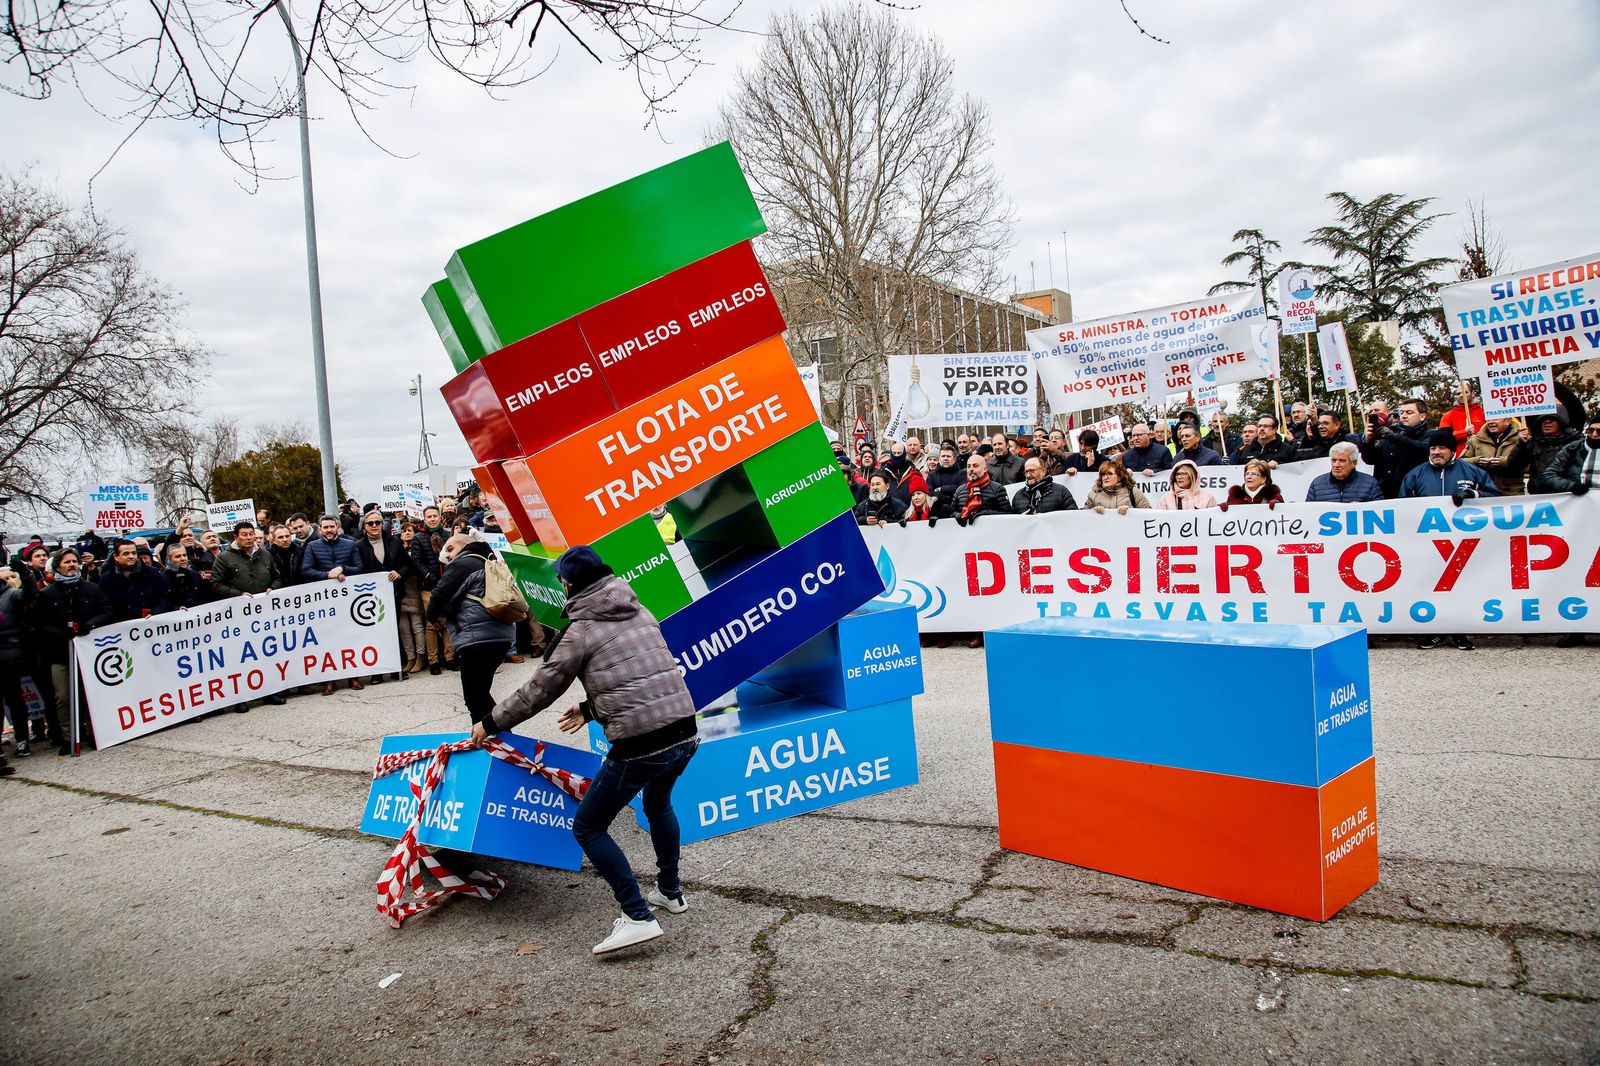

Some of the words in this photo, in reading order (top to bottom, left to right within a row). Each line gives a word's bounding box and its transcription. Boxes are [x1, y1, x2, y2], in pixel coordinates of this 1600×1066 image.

[1491, 281, 1513, 300] SI
[1519, 261, 1600, 295] RECOR
[1286, 307, 1316, 318] RECOR
[1292, 301, 1306, 310] NO
[1457, 287, 1595, 329] TRASVASE,
[1051, 346, 1061, 357] el
[1063, 341, 1090, 355] 50%
[1092, 336, 1133, 350] menos
[1135, 331, 1150, 342] de
[1152, 326, 1185, 340] agua
[1188, 320, 1207, 333] del
[1210, 306, 1266, 327] Trasvase
[1059, 331, 1078, 343] SR.
[1081, 318, 1149, 340] MINISTRA,
[1151, 316, 1168, 326] en
[1290, 320, 1314, 328] TRASVA
[1451, 334, 1476, 351] EL
[1478, 313, 1576, 347] FUTURO
[1580, 307, 1600, 328] D
[505, 362, 594, 412] EMPLEOS
[598, 320, 682, 368] EMPLEOS
[688, 282, 767, 328] EMPLEOS
[943, 357, 964, 366] SIN
[966, 354, 1028, 364] TRASVASE
[1078, 352, 1106, 364] 50%
[1108, 346, 1148, 360] menos
[1150, 341, 1166, 354] de
[1168, 332, 1219, 349] empleo,
[1485, 335, 1580, 366] MURCIA
[1584, 331, 1600, 349] Y
[943, 365, 1028, 379] DESIERTO
[1074, 369, 1081, 380] y
[1084, 365, 1098, 376] de
[1100, 358, 1146, 374] activida
[1164, 342, 1229, 362] conómica,
[1487, 368, 1500, 378] En
[1502, 367, 1510, 376] el
[1511, 364, 1547, 376] Levante
[943, 382, 958, 396] Y
[965, 380, 1028, 396] PARO
[1063, 380, 1093, 394] NOS
[1095, 371, 1146, 389] QUITAN
[1108, 388, 1117, 398] Y
[1122, 385, 1138, 396] EL
[1490, 383, 1548, 400] DESIERTO
[1493, 376, 1513, 388] SIN
[1514, 373, 1544, 386] AGUA
[945, 398, 984, 408] PARA
[988, 397, 1029, 408] MILES
[1500, 398, 1510, 408] Y
[1511, 393, 1545, 406] PARO
[597, 398, 701, 465] FLOTA
[698, 372, 745, 412] DE
[945, 412, 962, 422] DE
[966, 410, 1029, 420] FAMILIAS
[1100, 420, 1112, 428] AL
[584, 394, 788, 517] TRANSPORTE
[90, 492, 149, 502] TRASVASE
[98, 485, 140, 494] MENOS
[764, 464, 836, 509] AGRICULTURA
[1136, 483, 1150, 494] IN
[96, 518, 145, 528] FUTURO
[98, 510, 142, 520] MENOS
[1144, 519, 1171, 538] En
[1178, 517, 1199, 538] el
[1208, 514, 1310, 540] Levante,
[1318, 508, 1396, 537] SIN
[1416, 502, 1564, 534] AGUA
[616, 552, 669, 584] ULTURA
[964, 542, 1402, 596] DESIERTO
[1432, 538, 1481, 592] Y
[1510, 534, 1600, 590] P
[520, 579, 568, 608] AGRICULTUR
[129, 606, 233, 642] Comunidad
[243, 603, 263, 616] de
[271, 585, 350, 611] Regantes
[673, 588, 798, 679] SUMIDERO
[800, 562, 846, 596] CO2
[1036, 600, 1268, 622] TRASVASE
[1308, 600, 1436, 623] TAJO
[1482, 596, 1588, 622] SEG
[152, 631, 212, 657] Campo
[220, 625, 241, 640] de
[250, 606, 338, 633] Cartagena
[177, 646, 224, 678] SIN
[240, 626, 319, 664] AGUA
[862, 643, 901, 662] AGUA
[846, 666, 862, 680] DE
[864, 655, 918, 676] TRASVASE
[118, 668, 264, 730] DESIERTO
[276, 660, 290, 682] Y
[304, 646, 379, 676] PARO
[1330, 682, 1357, 710] AGUA
[1318, 718, 1330, 736] DE
[1330, 700, 1368, 730] TRASVASE
[744, 728, 847, 778] AGUA
[514, 786, 566, 810] AGUA
[698, 794, 739, 828] DE
[744, 756, 892, 811] TRASVASE
[373, 794, 390, 820] DE
[486, 802, 508, 818] DE
[511, 807, 574, 830] TRASVAS
[1332, 814, 1356, 844] FLOTA
[1358, 806, 1368, 824] DE
